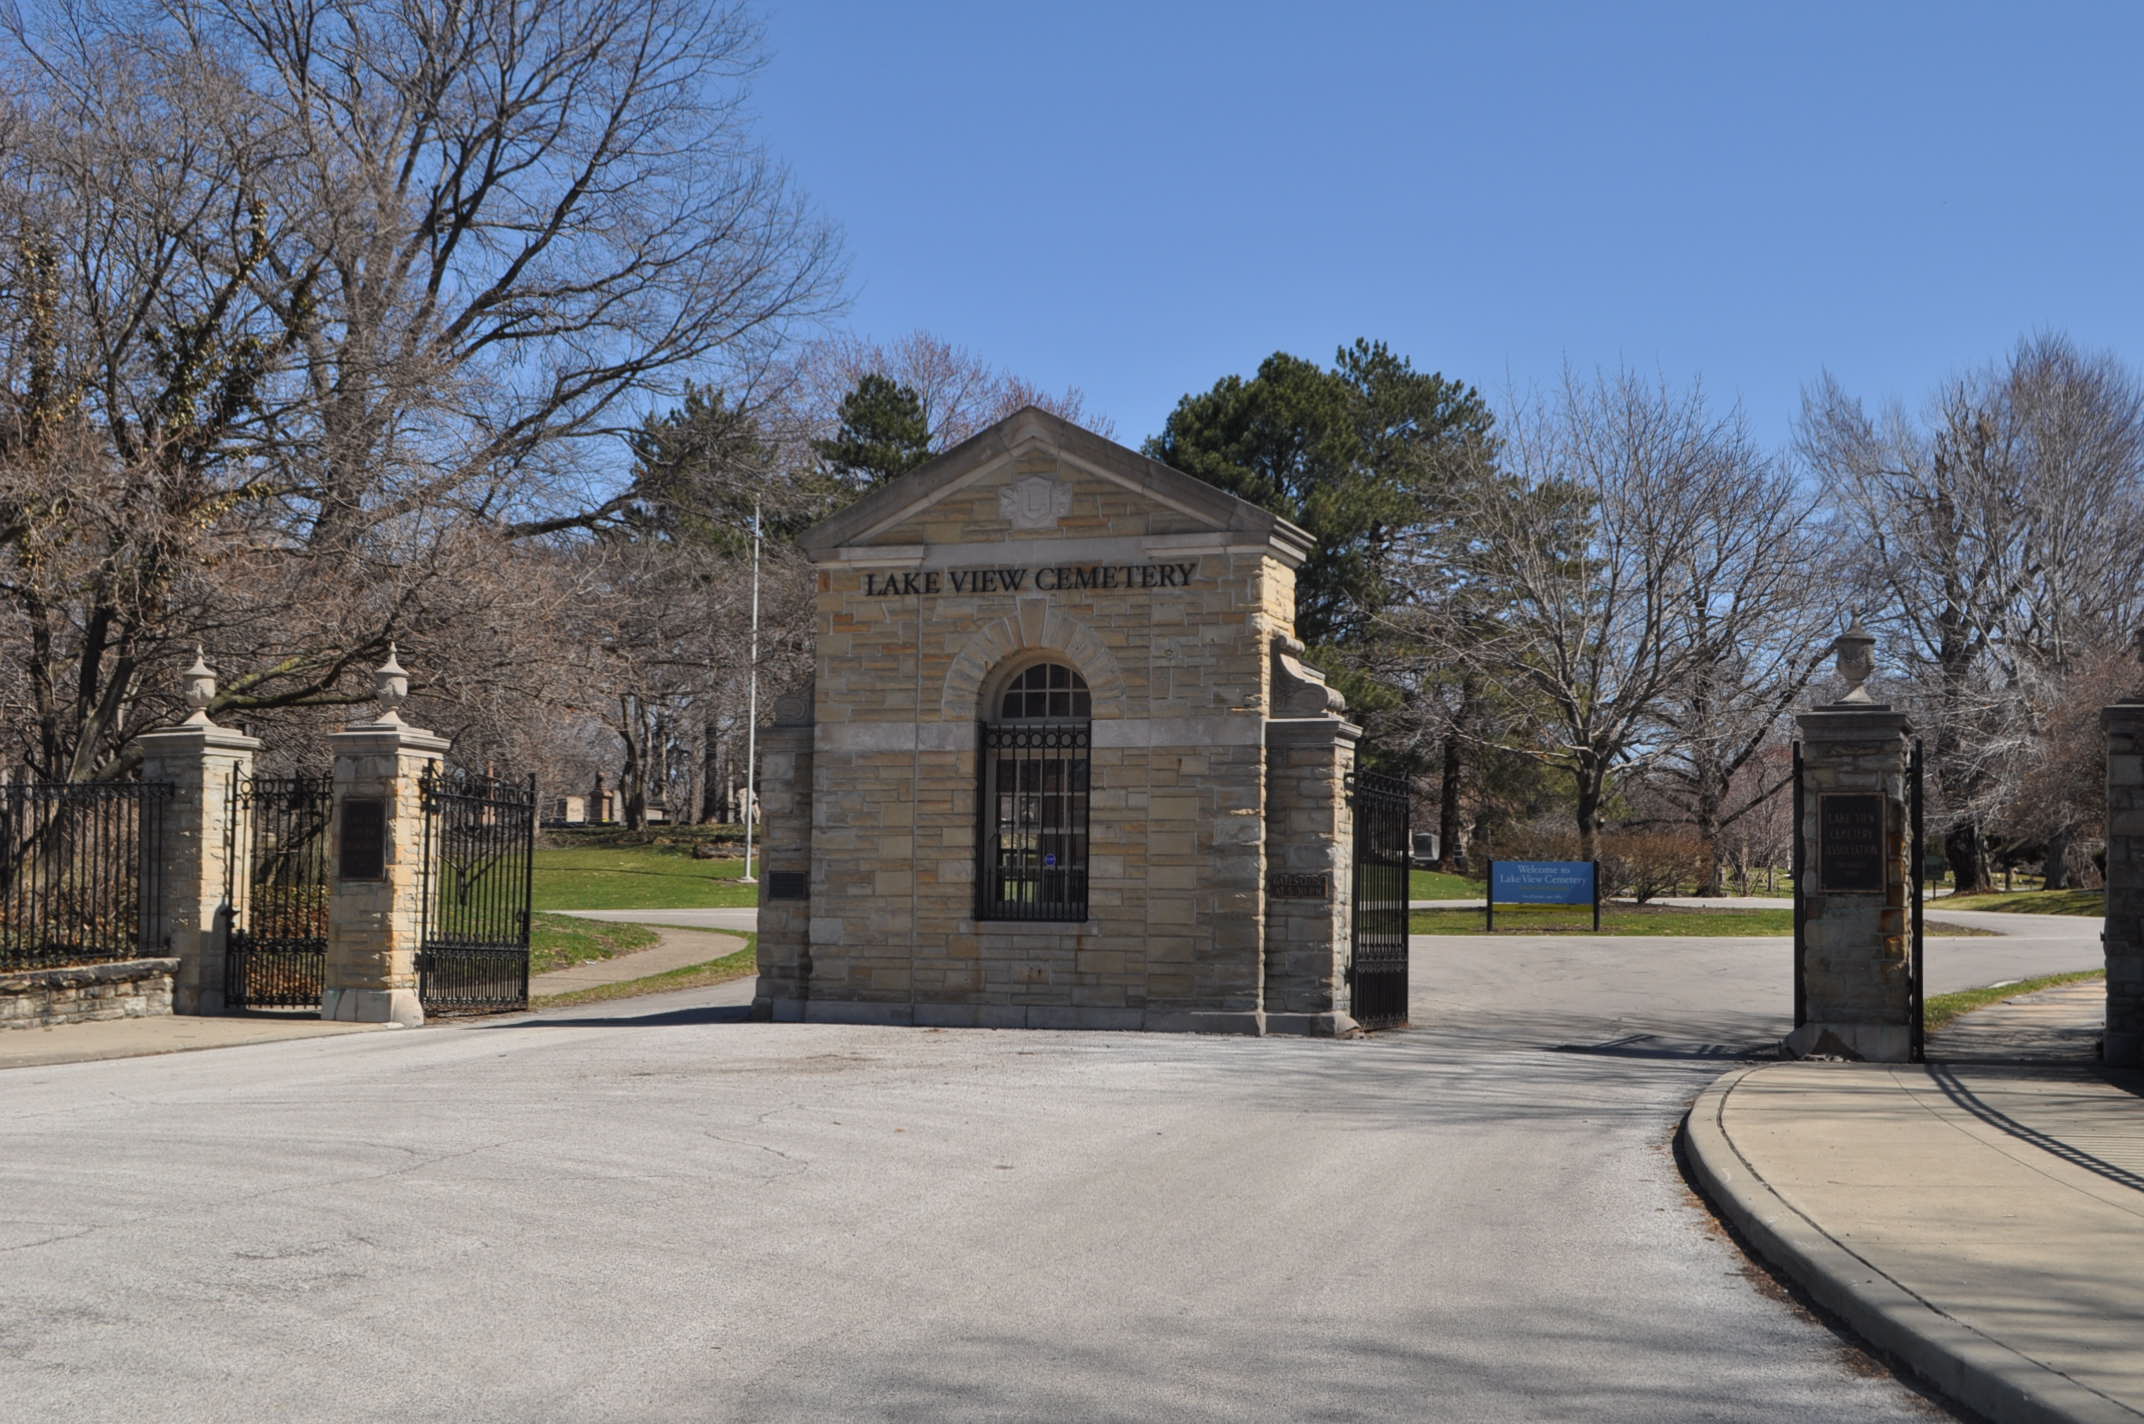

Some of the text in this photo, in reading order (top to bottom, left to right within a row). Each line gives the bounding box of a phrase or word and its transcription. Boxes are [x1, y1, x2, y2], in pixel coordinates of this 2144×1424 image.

[866, 563, 1197, 597] LAKE VIEW CEMETERY
[1517, 863, 1571, 874] Welcome to
[1500, 873, 1520, 884] Lake
[1520, 873, 1544, 884] View
[1544, 874, 1587, 889] Cemetery
